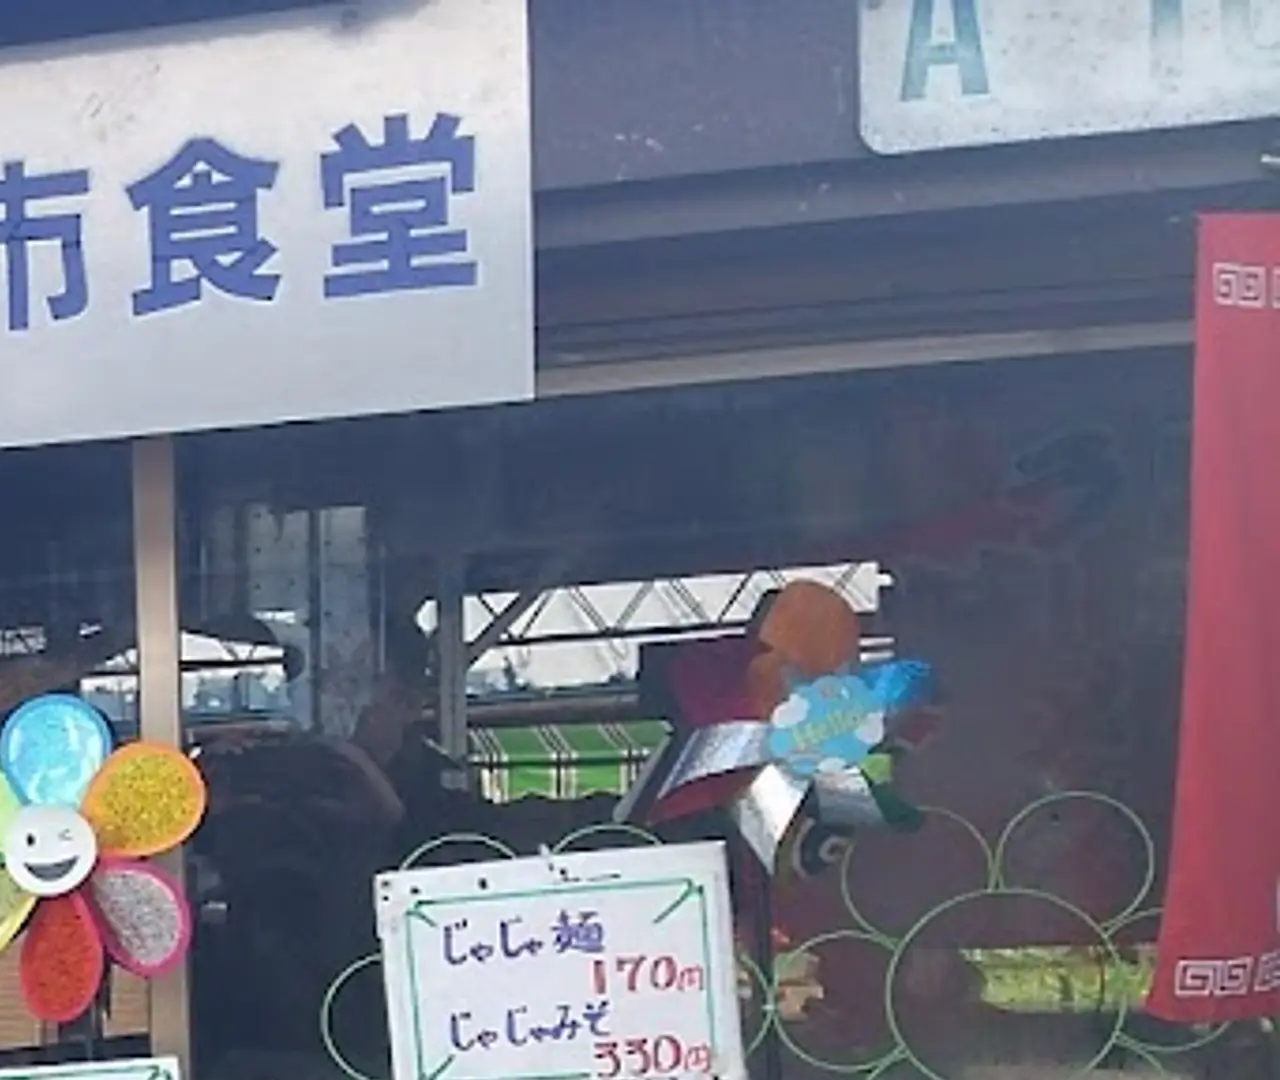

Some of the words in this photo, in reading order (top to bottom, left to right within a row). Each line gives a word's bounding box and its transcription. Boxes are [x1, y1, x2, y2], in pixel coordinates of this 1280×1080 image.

[443, 909, 606, 965] じゃじゃ麺
[592, 955, 705, 996] 170円
[450, 999, 613, 1051] じゃじゃみそ
